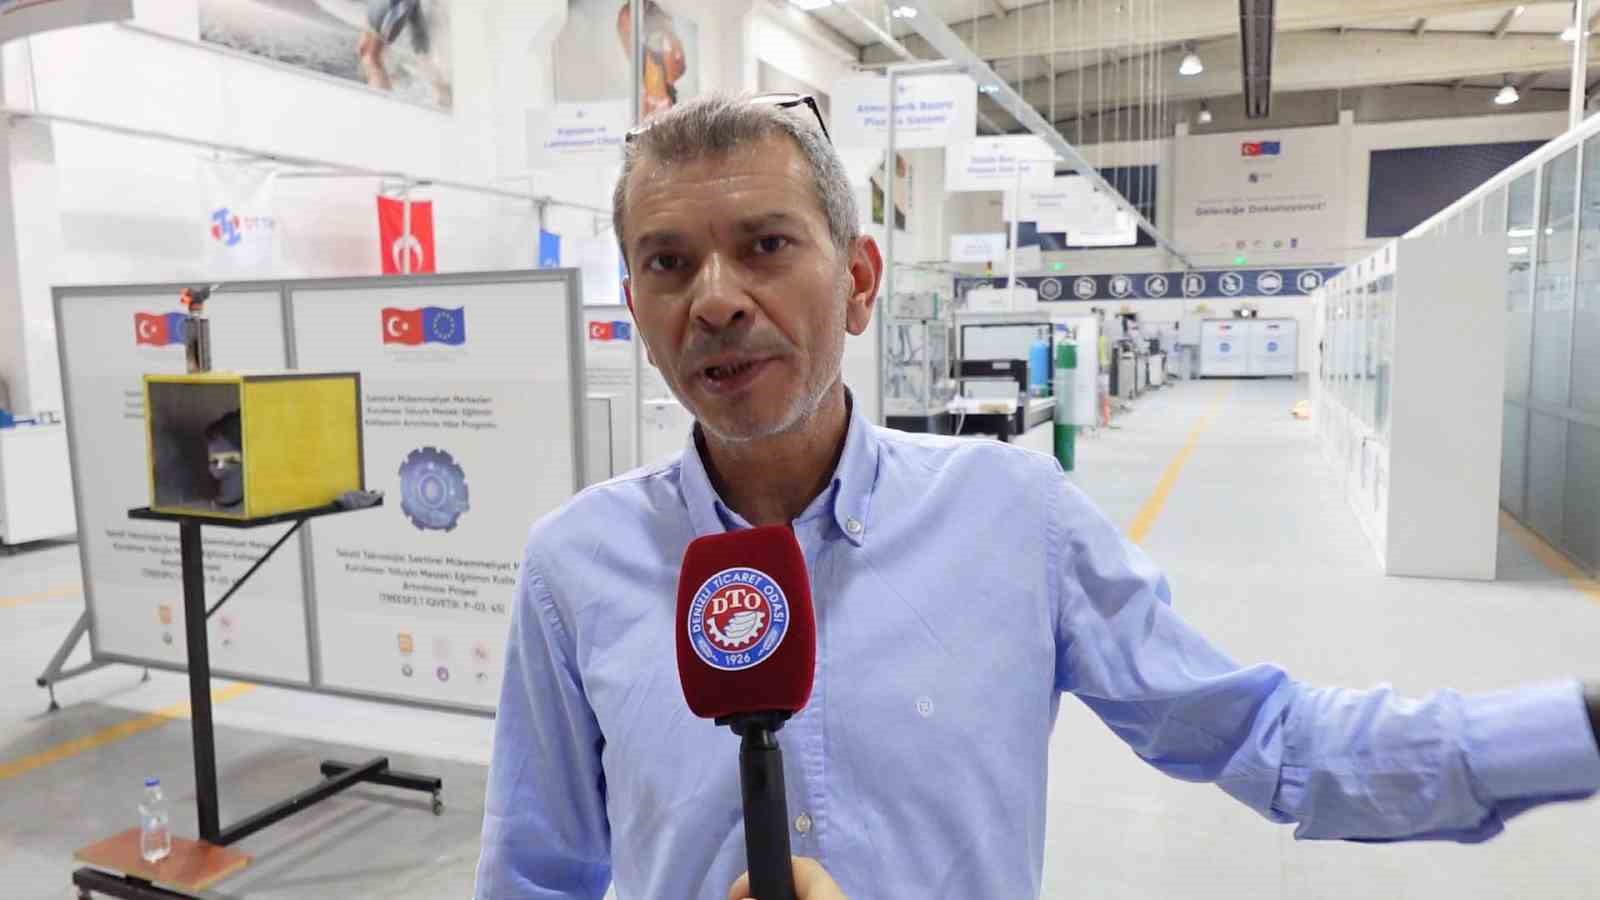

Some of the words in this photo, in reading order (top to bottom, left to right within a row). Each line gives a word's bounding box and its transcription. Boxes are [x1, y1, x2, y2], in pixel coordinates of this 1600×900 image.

[711, 588, 762, 615] DTO
[763, 584, 785, 623] ODASI
[725, 653, 751, 666] 1926
